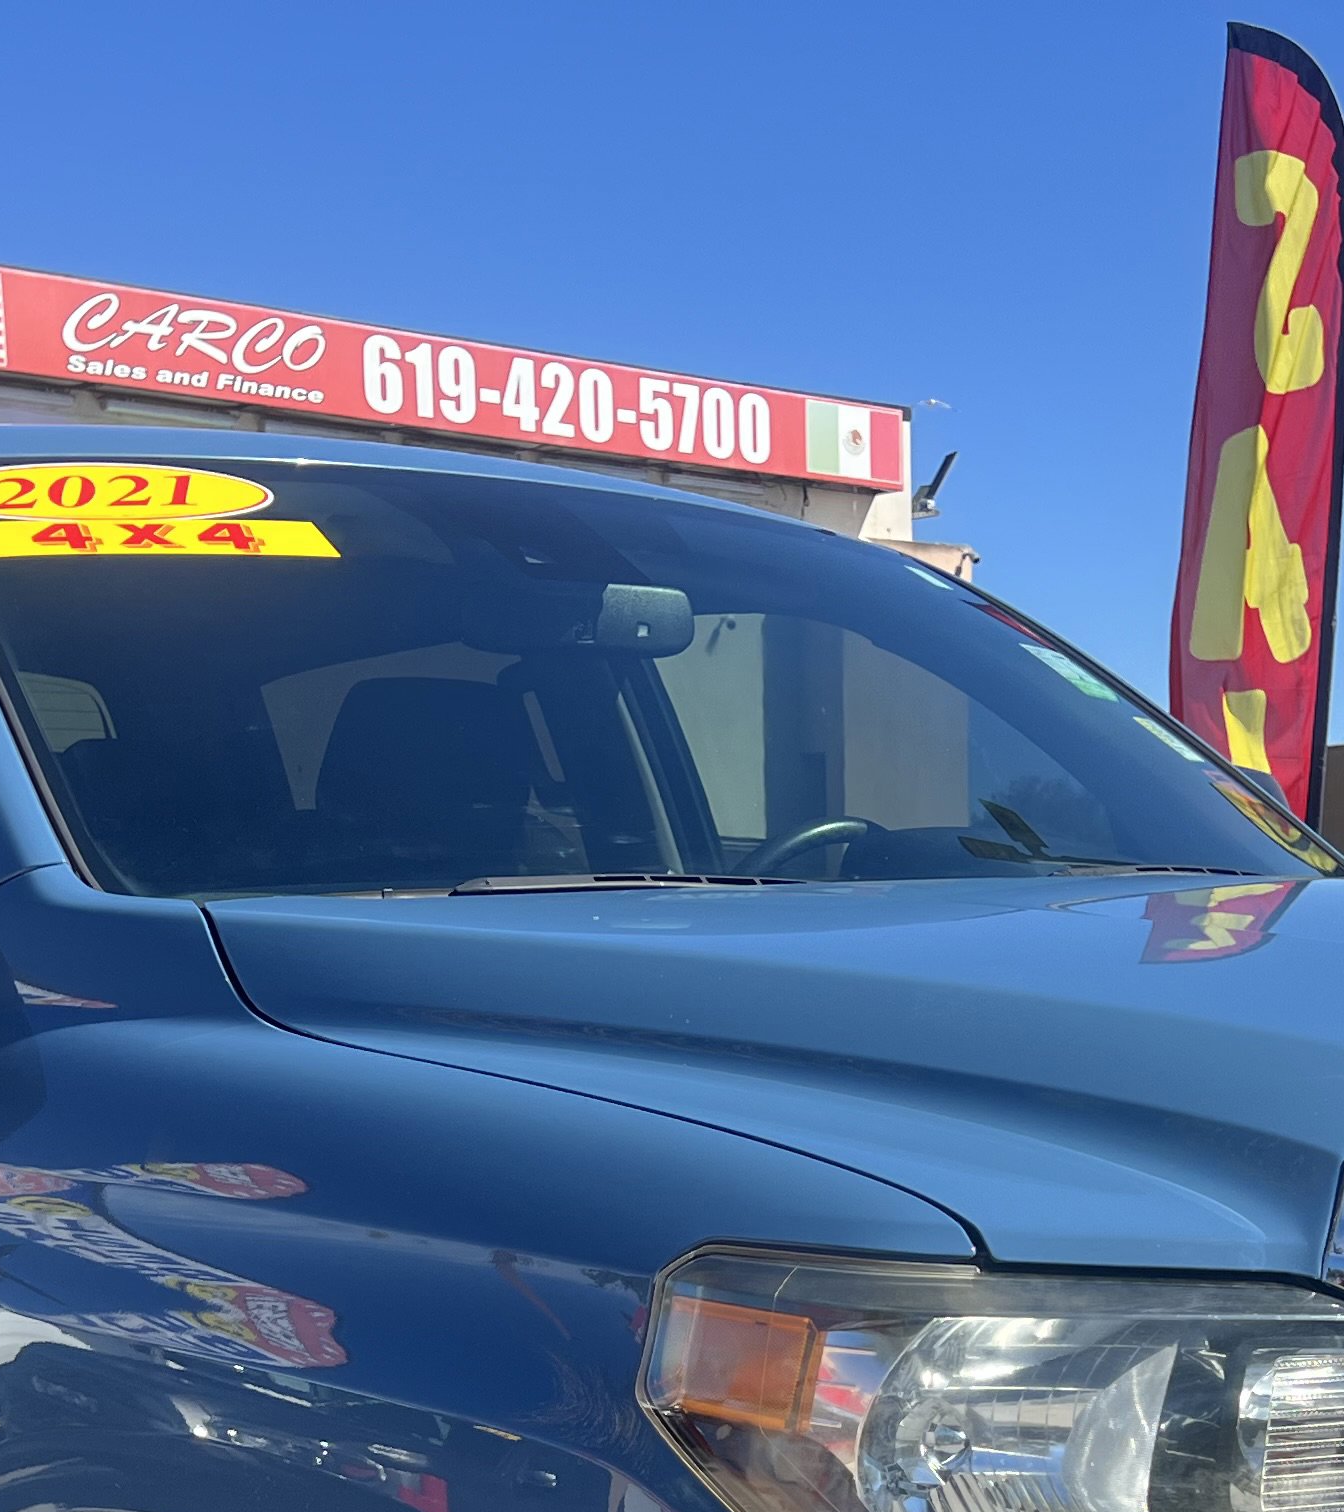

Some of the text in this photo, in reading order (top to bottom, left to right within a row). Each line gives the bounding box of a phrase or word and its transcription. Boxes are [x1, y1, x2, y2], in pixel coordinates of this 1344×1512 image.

[62, 292, 326, 374] CARCO
[66, 354, 325, 404] Sales and Finance
[362, 334, 771, 465] 619-420-5700
